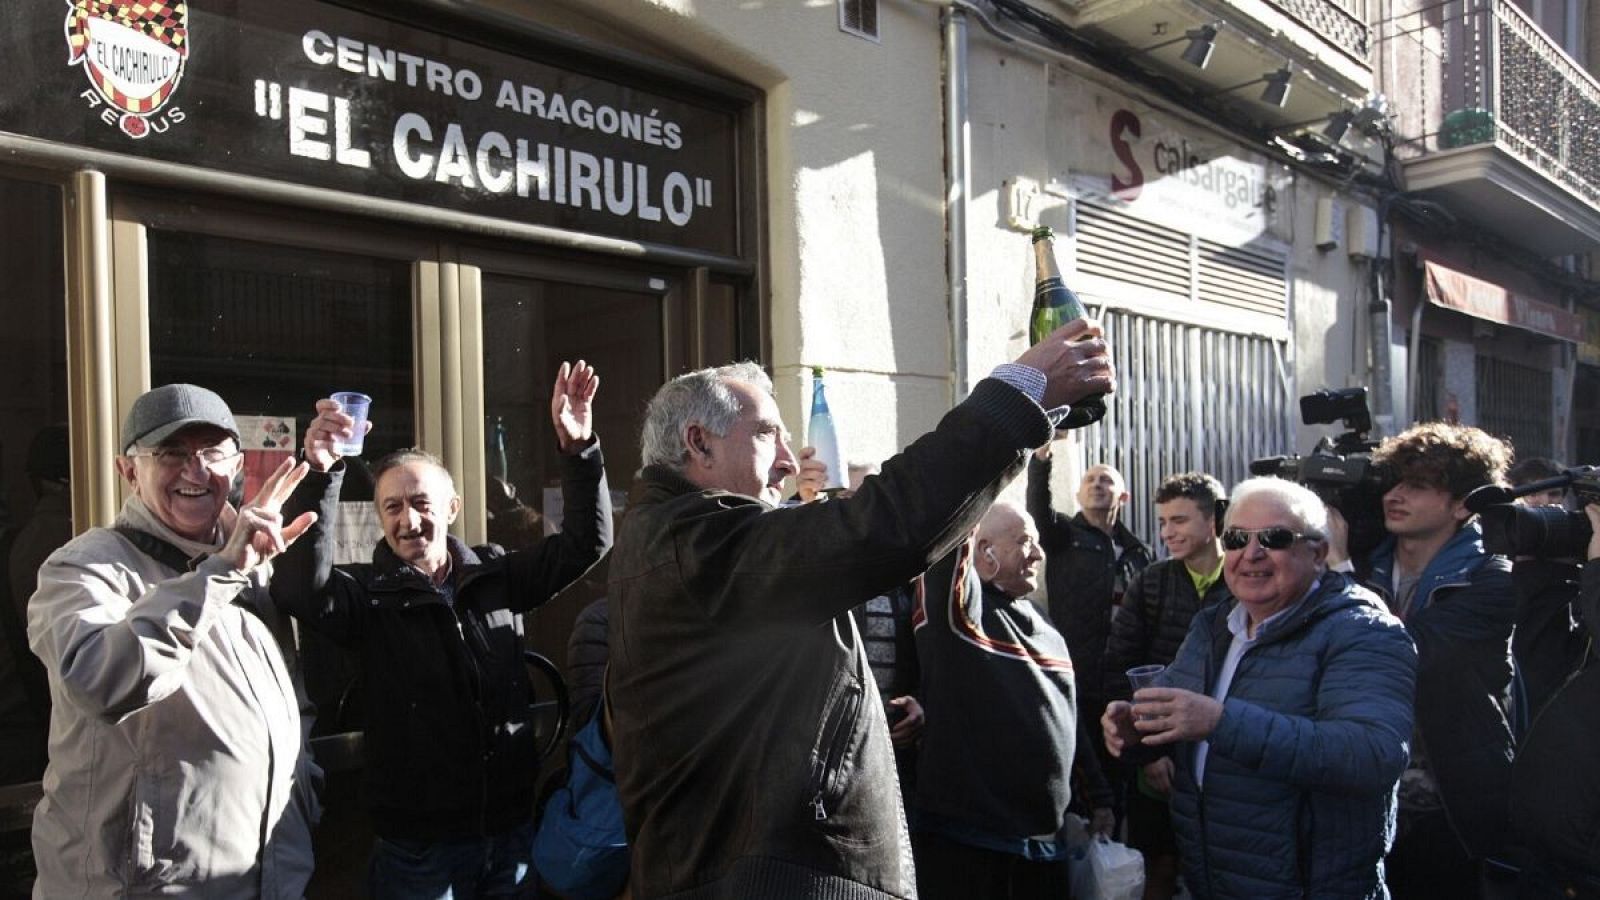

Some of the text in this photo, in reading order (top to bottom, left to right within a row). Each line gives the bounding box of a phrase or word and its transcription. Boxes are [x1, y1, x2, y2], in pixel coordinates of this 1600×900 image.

[254, 79, 713, 227] "EL CACHIRULO"
[302, 29, 683, 150] CENTRO ARAGONÉS
